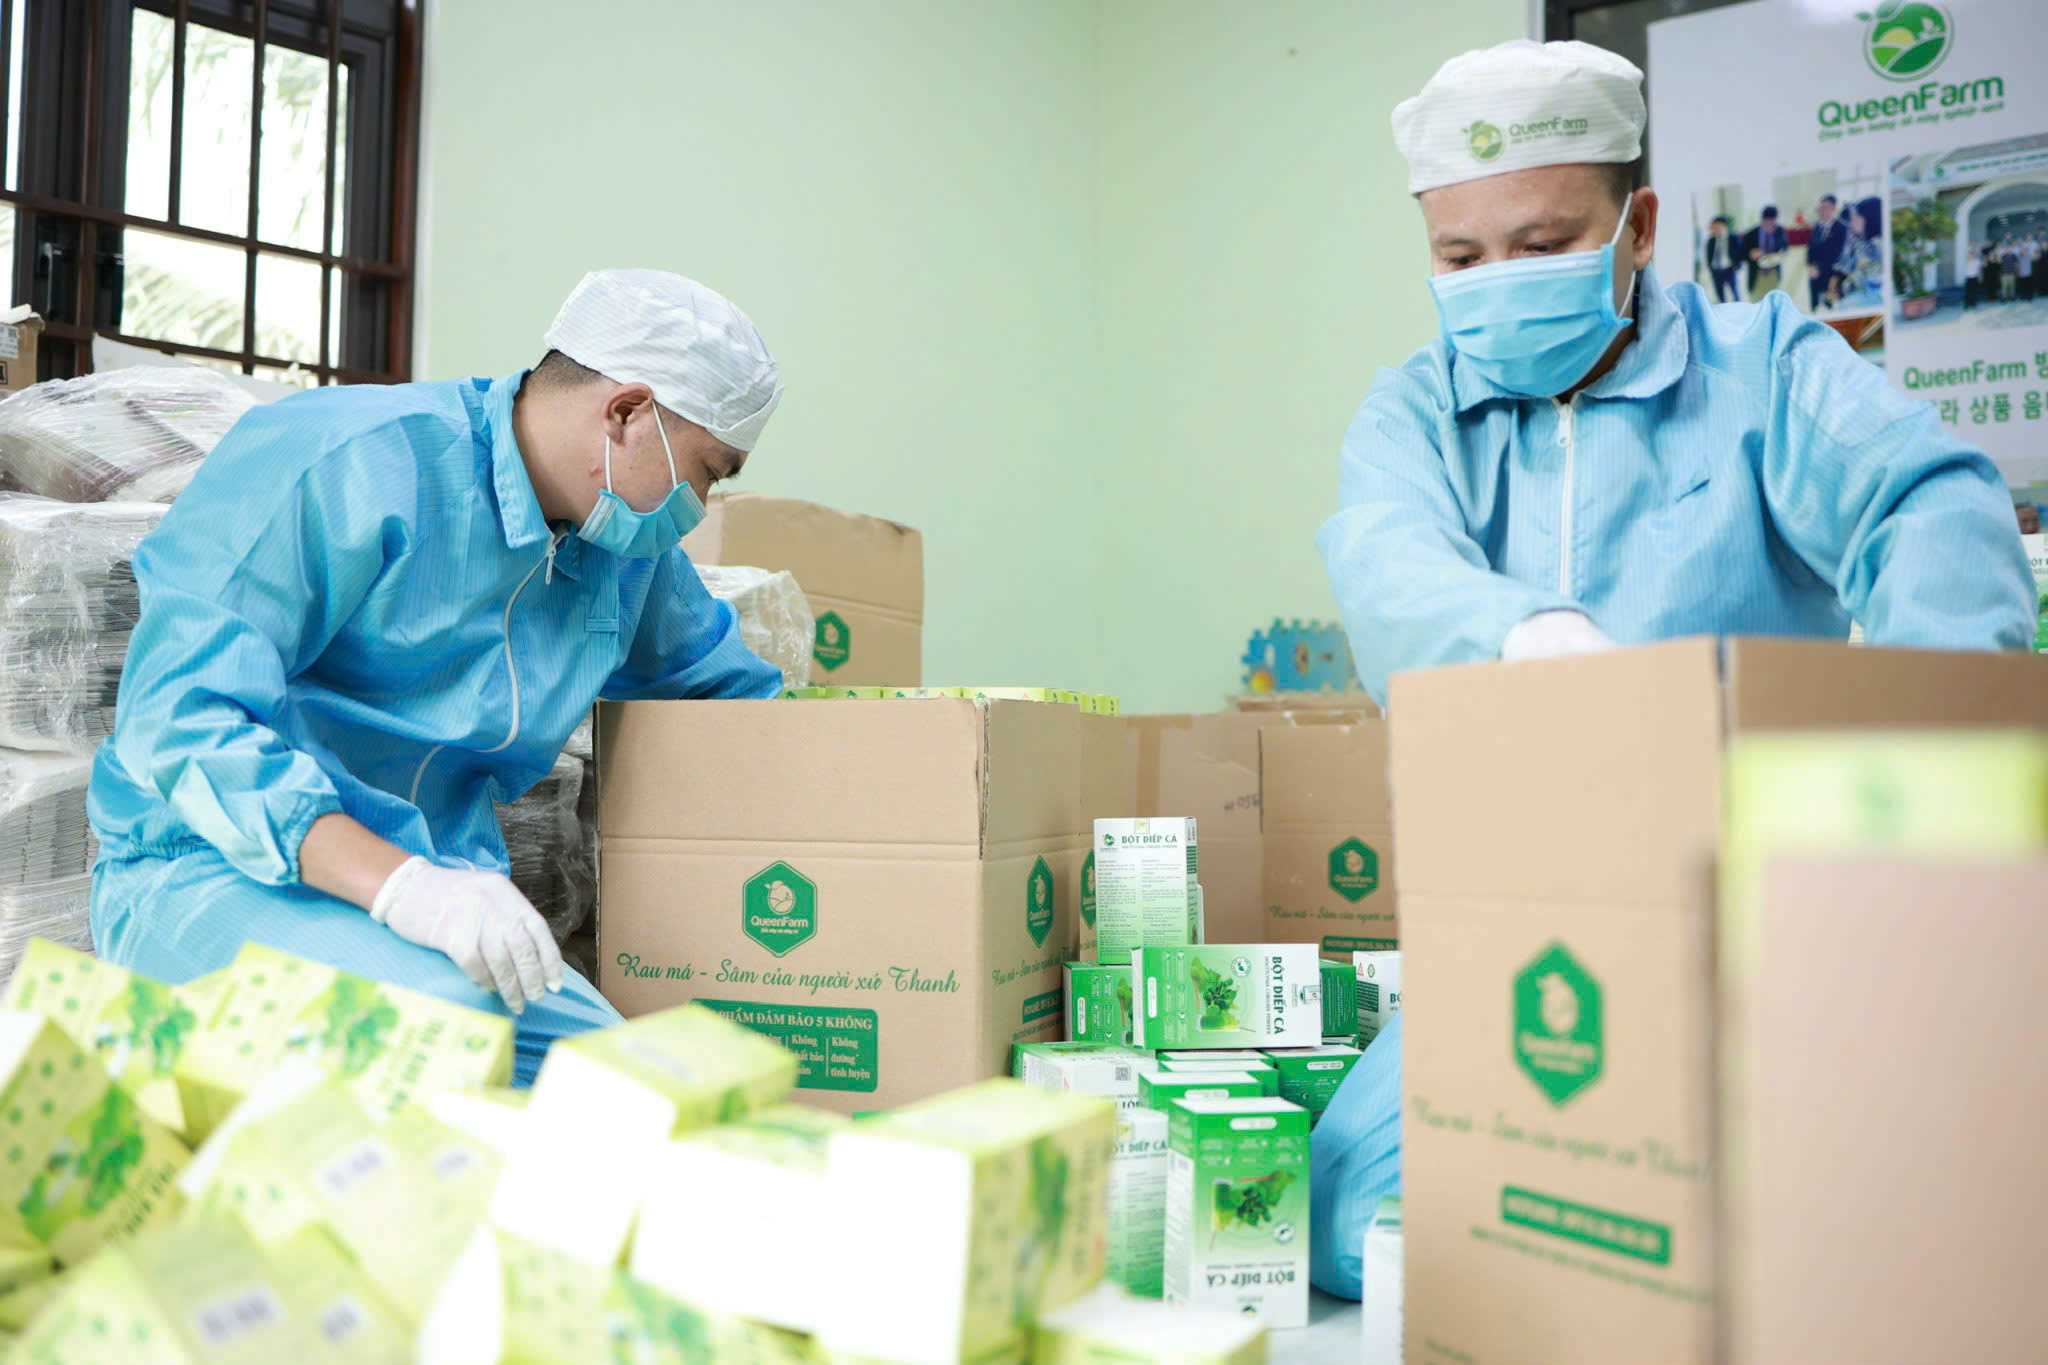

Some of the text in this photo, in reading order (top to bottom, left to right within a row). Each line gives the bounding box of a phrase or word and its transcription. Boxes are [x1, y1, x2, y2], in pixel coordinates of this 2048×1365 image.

[1818, 76, 2004, 128] QueenFarm
[1509, 116, 1588, 137] QueenFarm
[1904, 360, 2027, 390] QueenFarm
[751, 915, 808, 928] QueenFarm
[617, 953, 662, 979] Rau
[666, 963, 693, 981] má
[716, 958, 757, 984] Sâm
[762, 971, 795, 987] của
[799, 972, 850, 996] người
[888, 966, 960, 994] Thanh
[788, 1011, 813, 1027] BẢO
[816, 1016, 823, 1027] 5
[826, 1014, 872, 1030] KHÔNG
